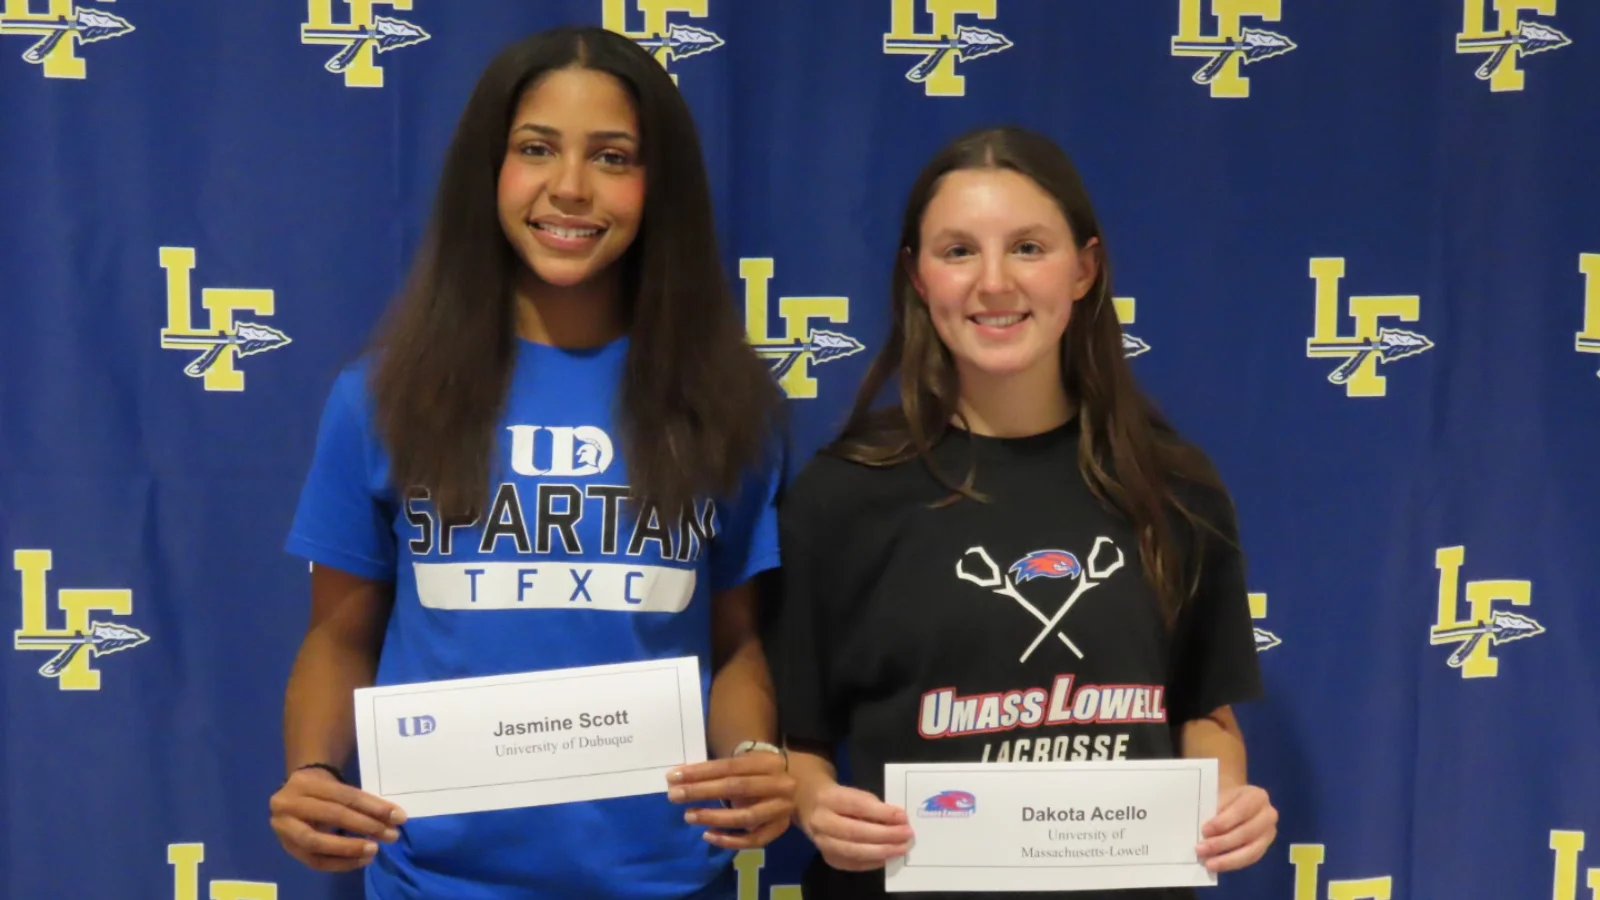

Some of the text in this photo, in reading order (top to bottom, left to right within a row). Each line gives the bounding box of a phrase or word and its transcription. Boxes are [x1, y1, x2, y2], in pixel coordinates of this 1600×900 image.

[159, 246, 274, 391] LF
[739, 257, 849, 399] LF
[1307, 257, 1420, 397] LF
[506, 425, 614, 477] UD
[14, 549, 132, 690] LF
[1430, 545, 1531, 678] LF
[493, 710, 629, 737] Jasmine Scott
[495, 734, 634, 757] University of Dubuque
[981, 734, 1130, 763] LACROSSE
[1021, 806, 1148, 822] Dakota Acello
[1021, 844, 1149, 858] Massachusetts-Lowell
[1048, 827, 1126, 843] University of
